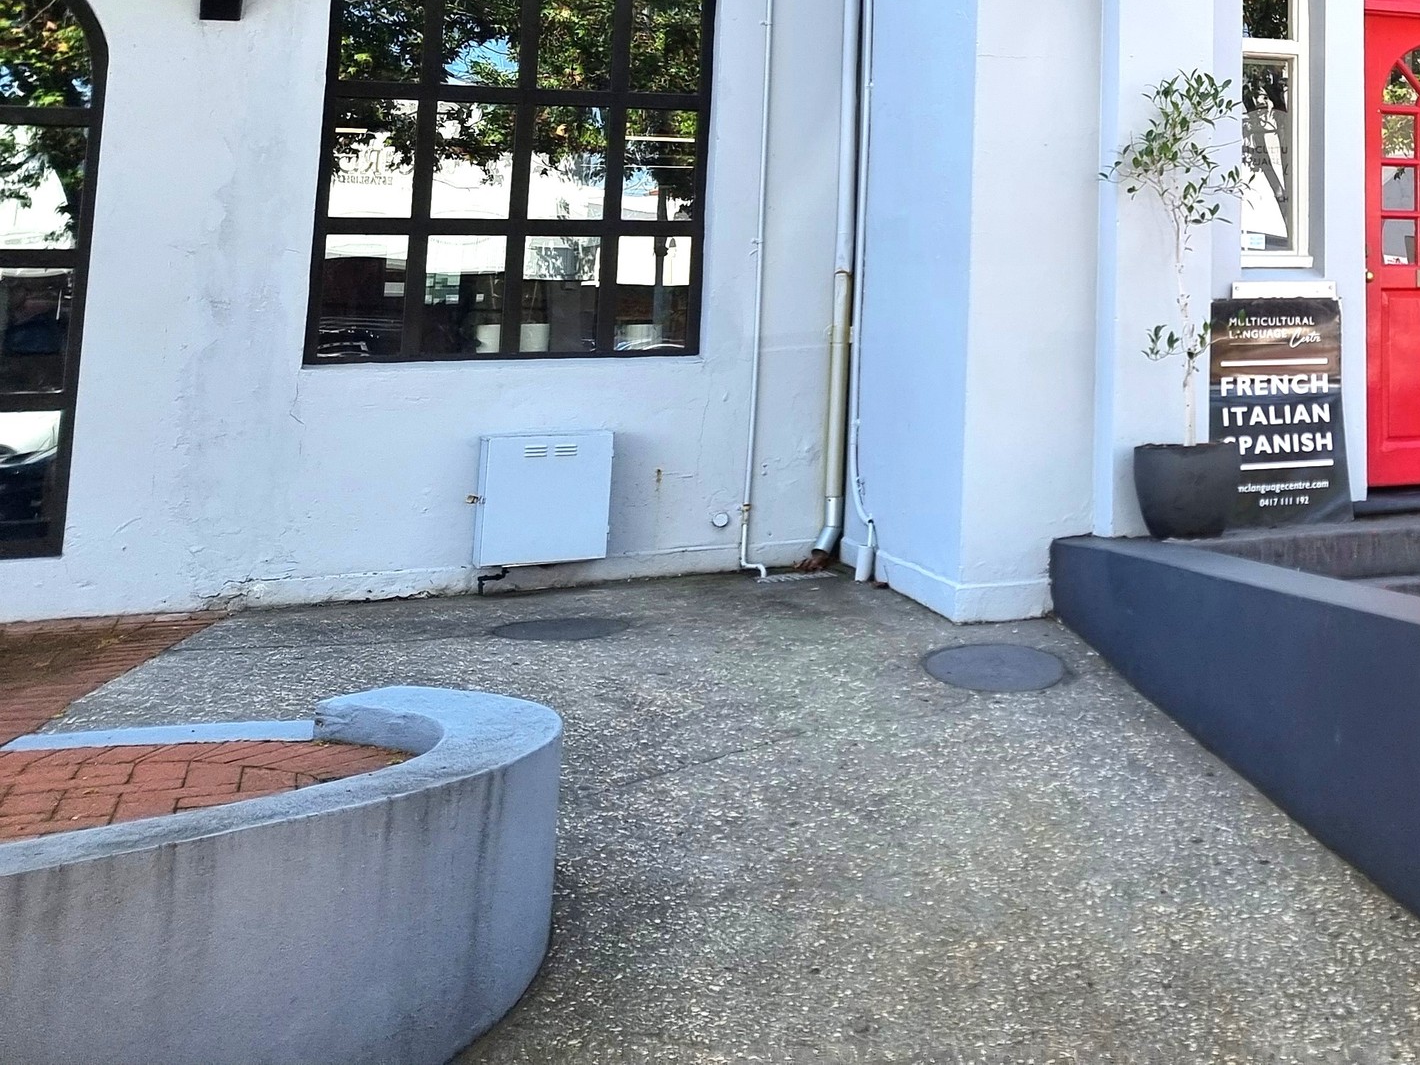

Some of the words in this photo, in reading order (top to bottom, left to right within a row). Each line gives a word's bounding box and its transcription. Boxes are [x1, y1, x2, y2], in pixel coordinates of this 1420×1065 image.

[1220, 373, 1329, 397] FRENCH
[1222, 403, 1331, 427] ITALIAN
[1259, 498, 1278, 507] 0417
[1296, 496, 1310, 505] 192
